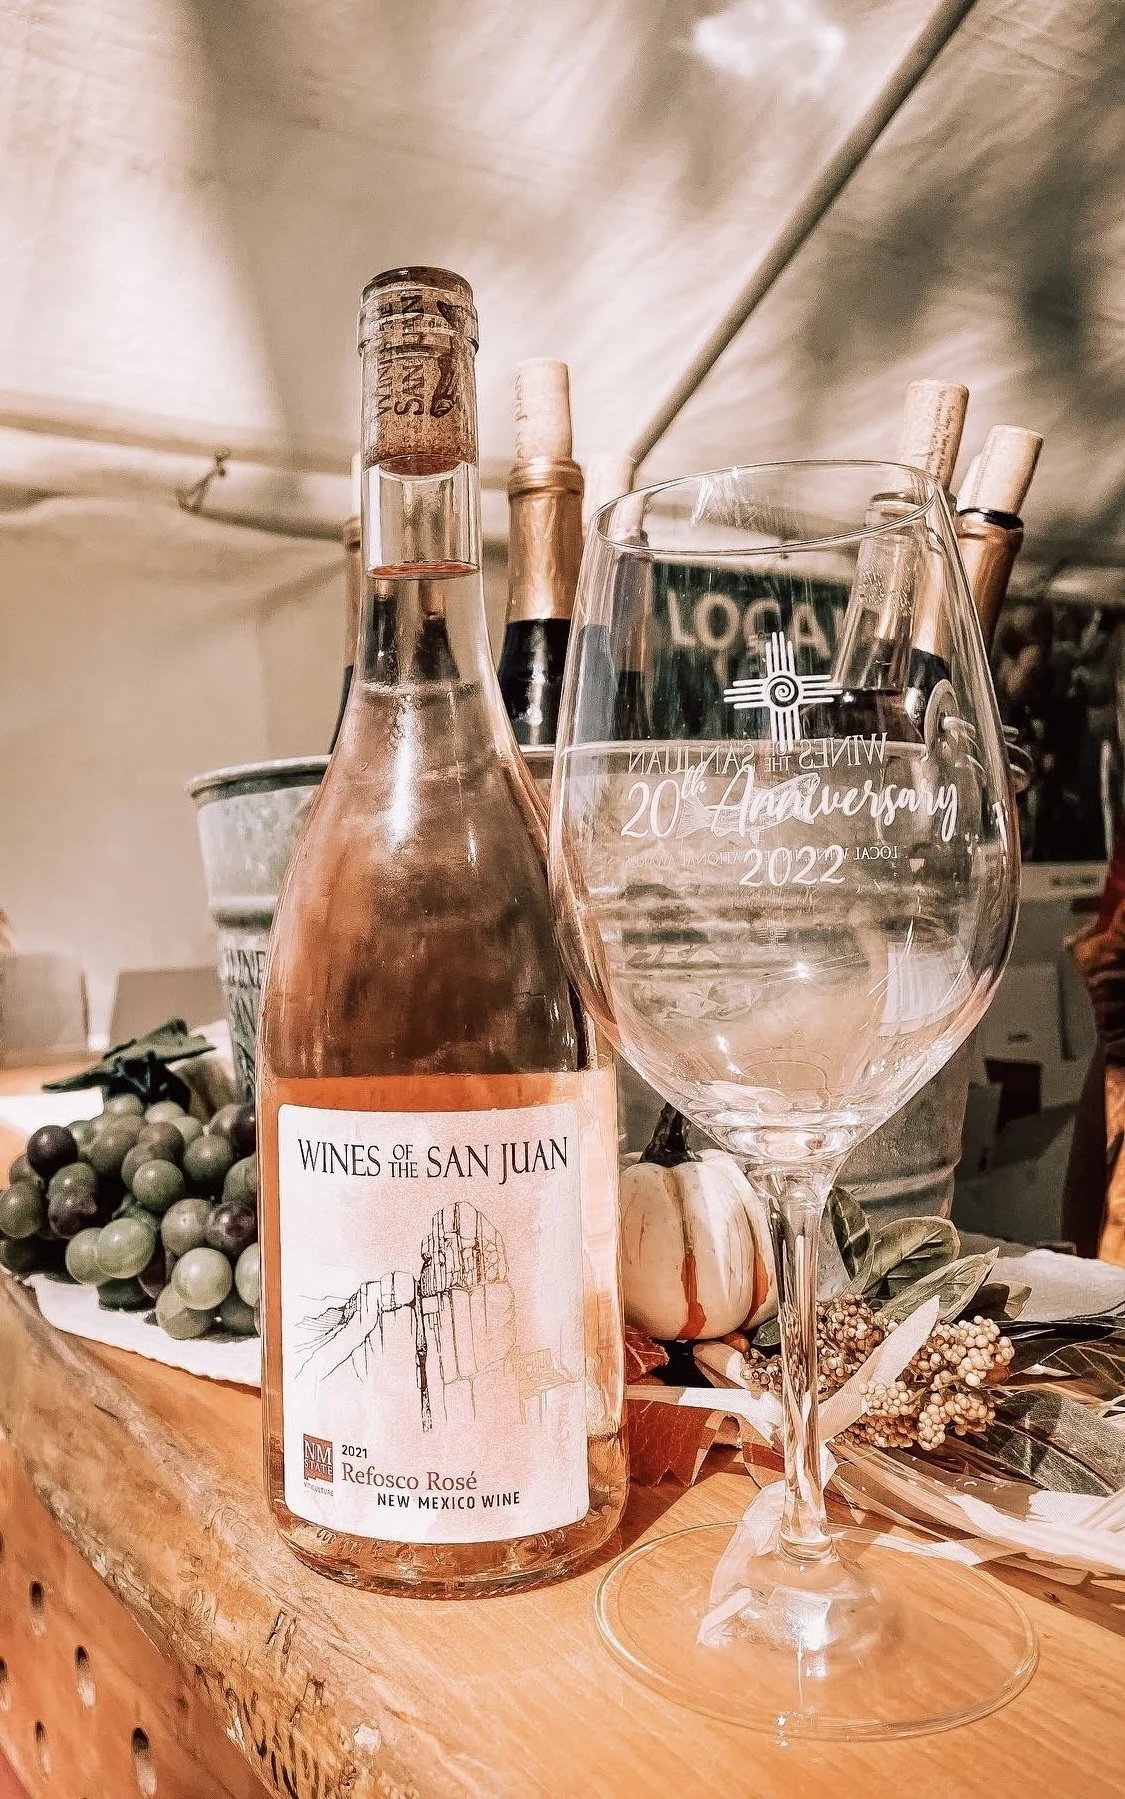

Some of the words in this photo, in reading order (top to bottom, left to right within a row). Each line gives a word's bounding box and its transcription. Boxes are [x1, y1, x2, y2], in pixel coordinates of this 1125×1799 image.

[393, 363, 425, 416] SAN
[620, 762, 708, 838] 20th
[703, 763, 959, 842] Anniversary
[739, 844, 847, 887] 2022
[298, 1138, 381, 1177] WINES
[392, 1143, 414, 1161] OF
[427, 1144, 490, 1178] SAN
[499, 1136, 568, 1185] JUAN
[388, 1161, 418, 1179] THE
[304, 1439, 333, 1466] NM
[341, 1444, 368, 1459] 2021
[304, 1458, 333, 1476] STATE
[341, 1462, 419, 1490] Refosco
[426, 1471, 478, 1491] Rosé
[303, 1481, 334, 1497] VITICULTURE
[377, 1492, 410, 1508] NEW
[418, 1495, 475, 1510] MEXICO
[481, 1491, 520, 1508] WINE
